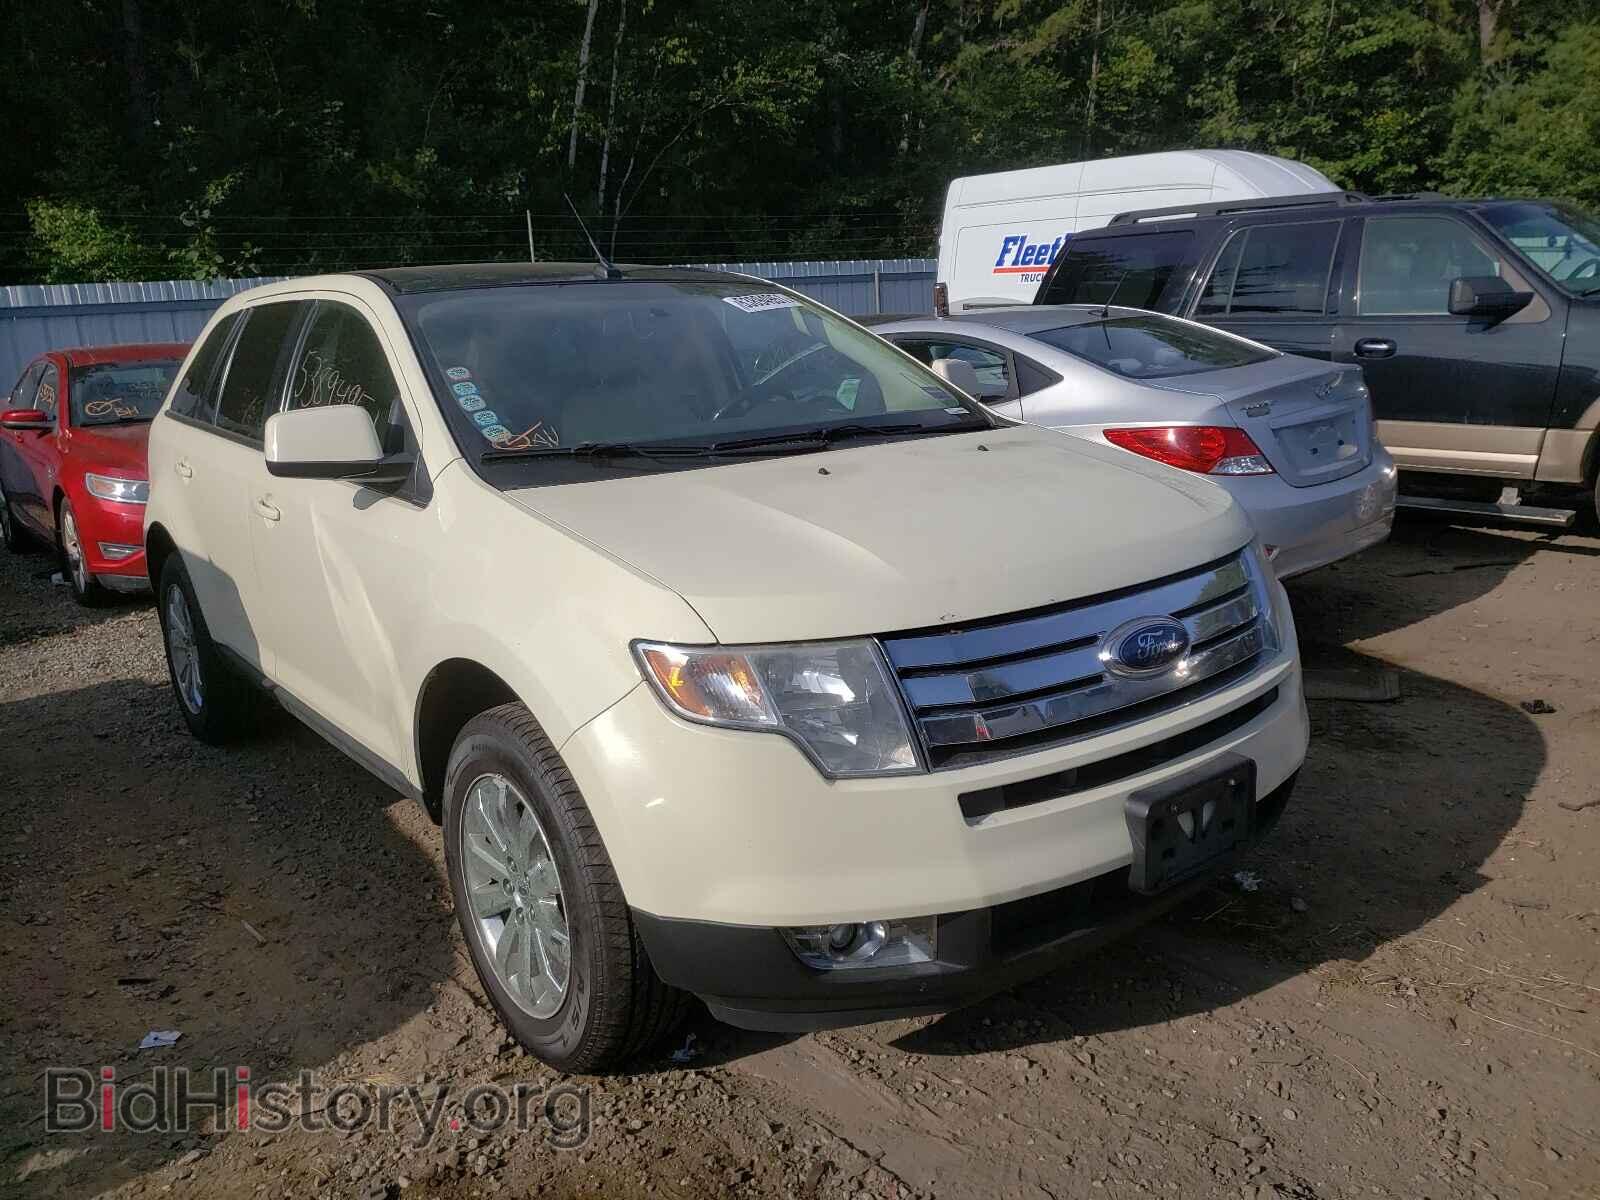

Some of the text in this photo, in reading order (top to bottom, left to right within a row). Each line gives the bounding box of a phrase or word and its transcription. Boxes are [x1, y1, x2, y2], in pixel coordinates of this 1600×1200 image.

[995, 233, 1071, 267] Fleet
[1020, 273, 1046, 283] TRUC
[1137, 629, 1178, 660] Ford
